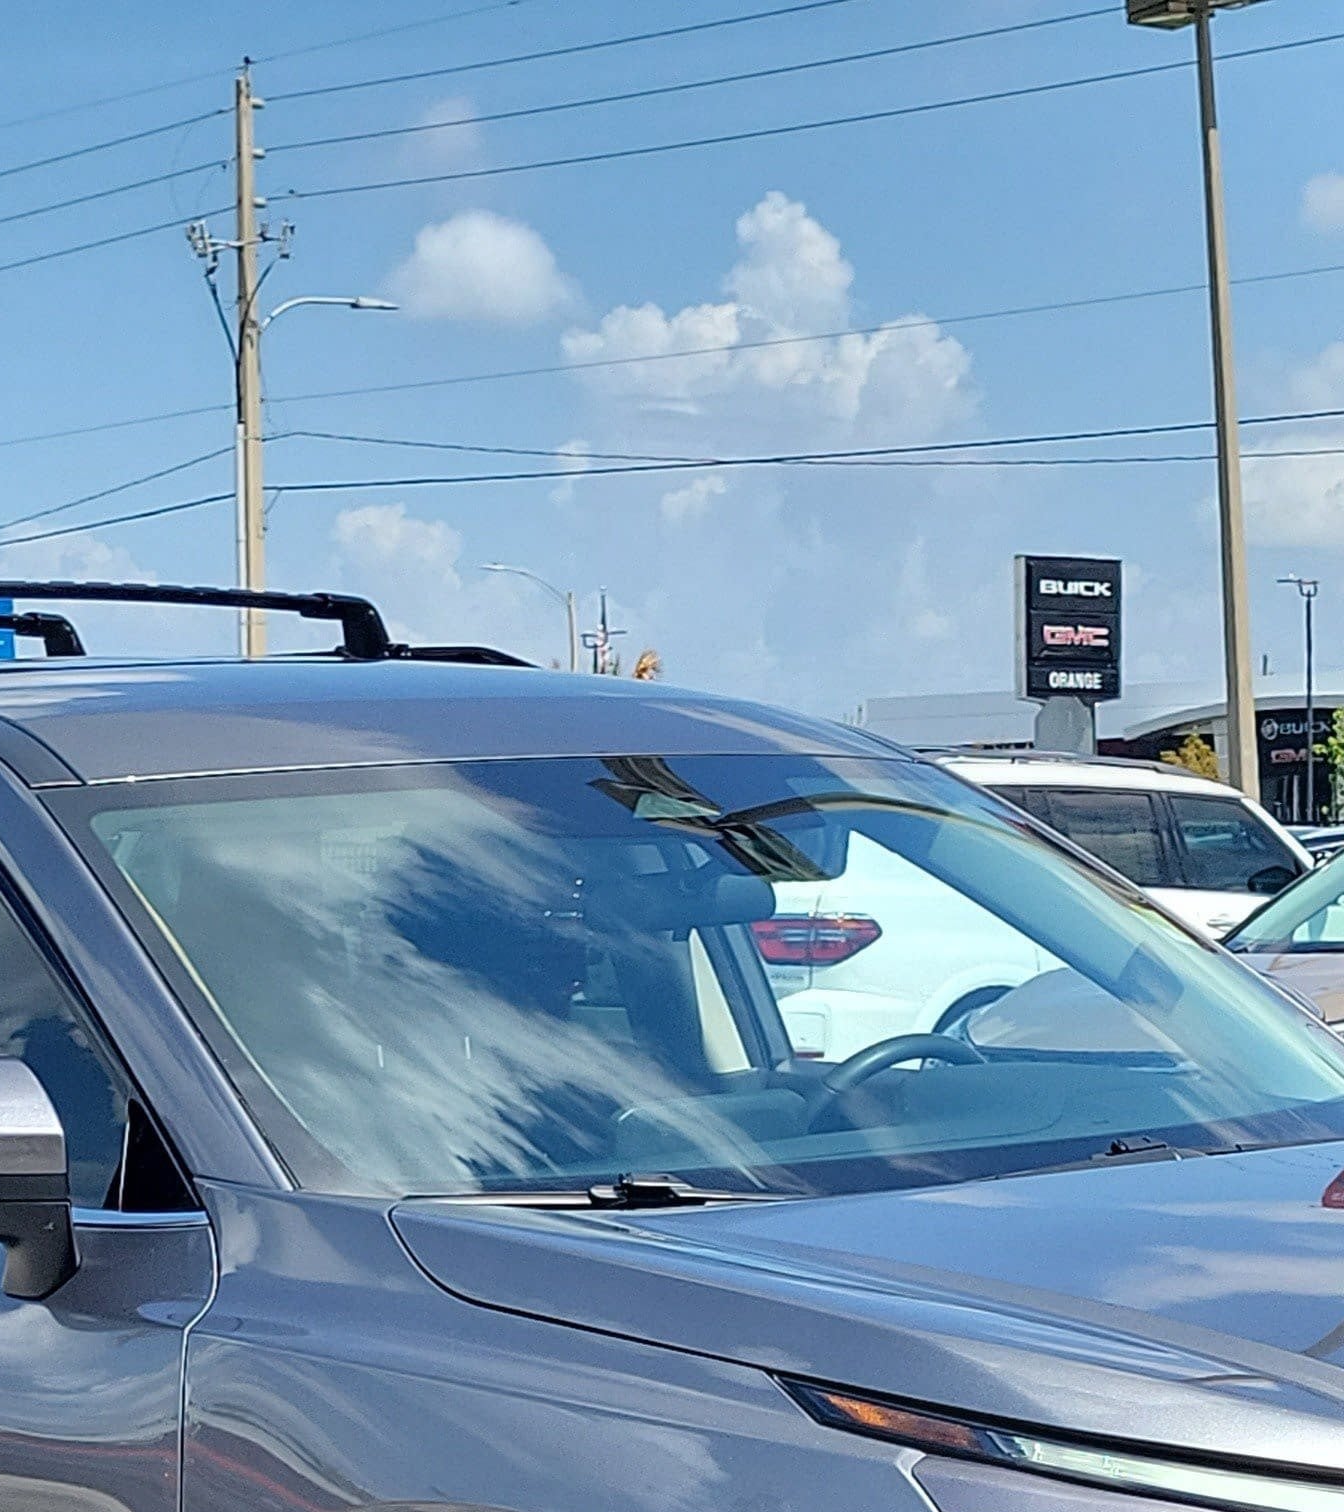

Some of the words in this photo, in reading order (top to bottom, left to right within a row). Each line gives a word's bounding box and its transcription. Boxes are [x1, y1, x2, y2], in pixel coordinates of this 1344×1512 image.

[1039, 579, 1111, 596] BUICK
[1043, 625, 1109, 646] GMC
[1049, 671, 1102, 689] ORANGE
